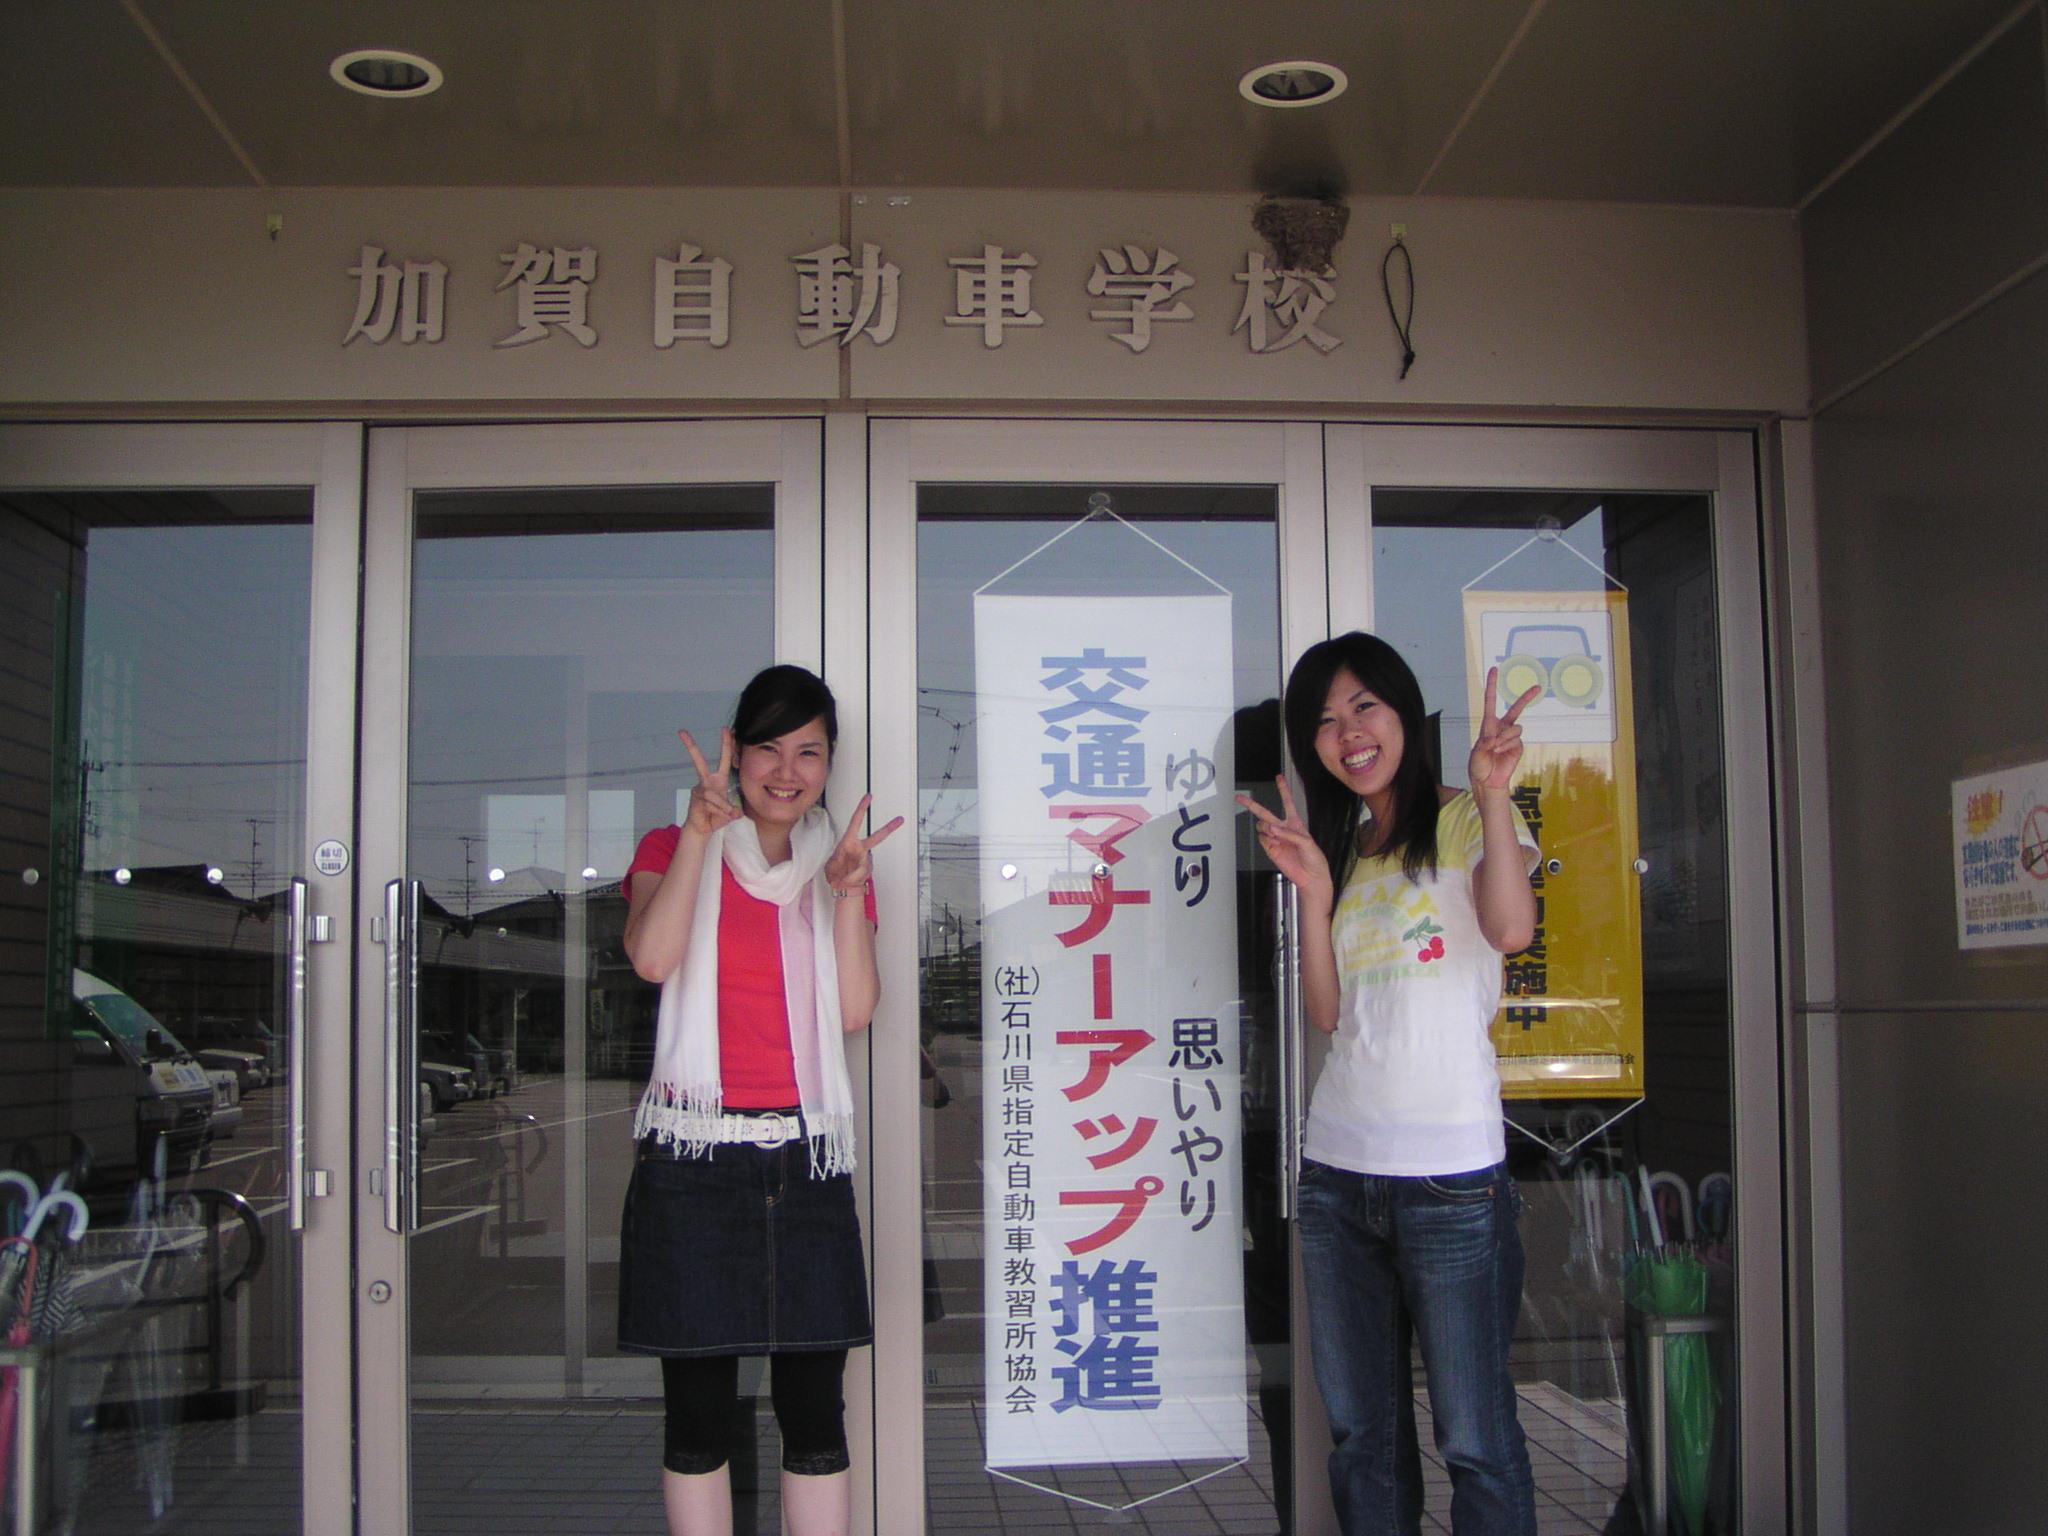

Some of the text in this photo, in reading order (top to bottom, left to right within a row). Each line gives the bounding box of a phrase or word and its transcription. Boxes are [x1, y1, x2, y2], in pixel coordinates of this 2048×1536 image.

[343, 243, 1344, 353] 加賀自動車学校
[1038, 648, 1164, 1414] 交通マナーアップ推進
[1165, 748, 1225, 1232] ゆとり 思いやり
